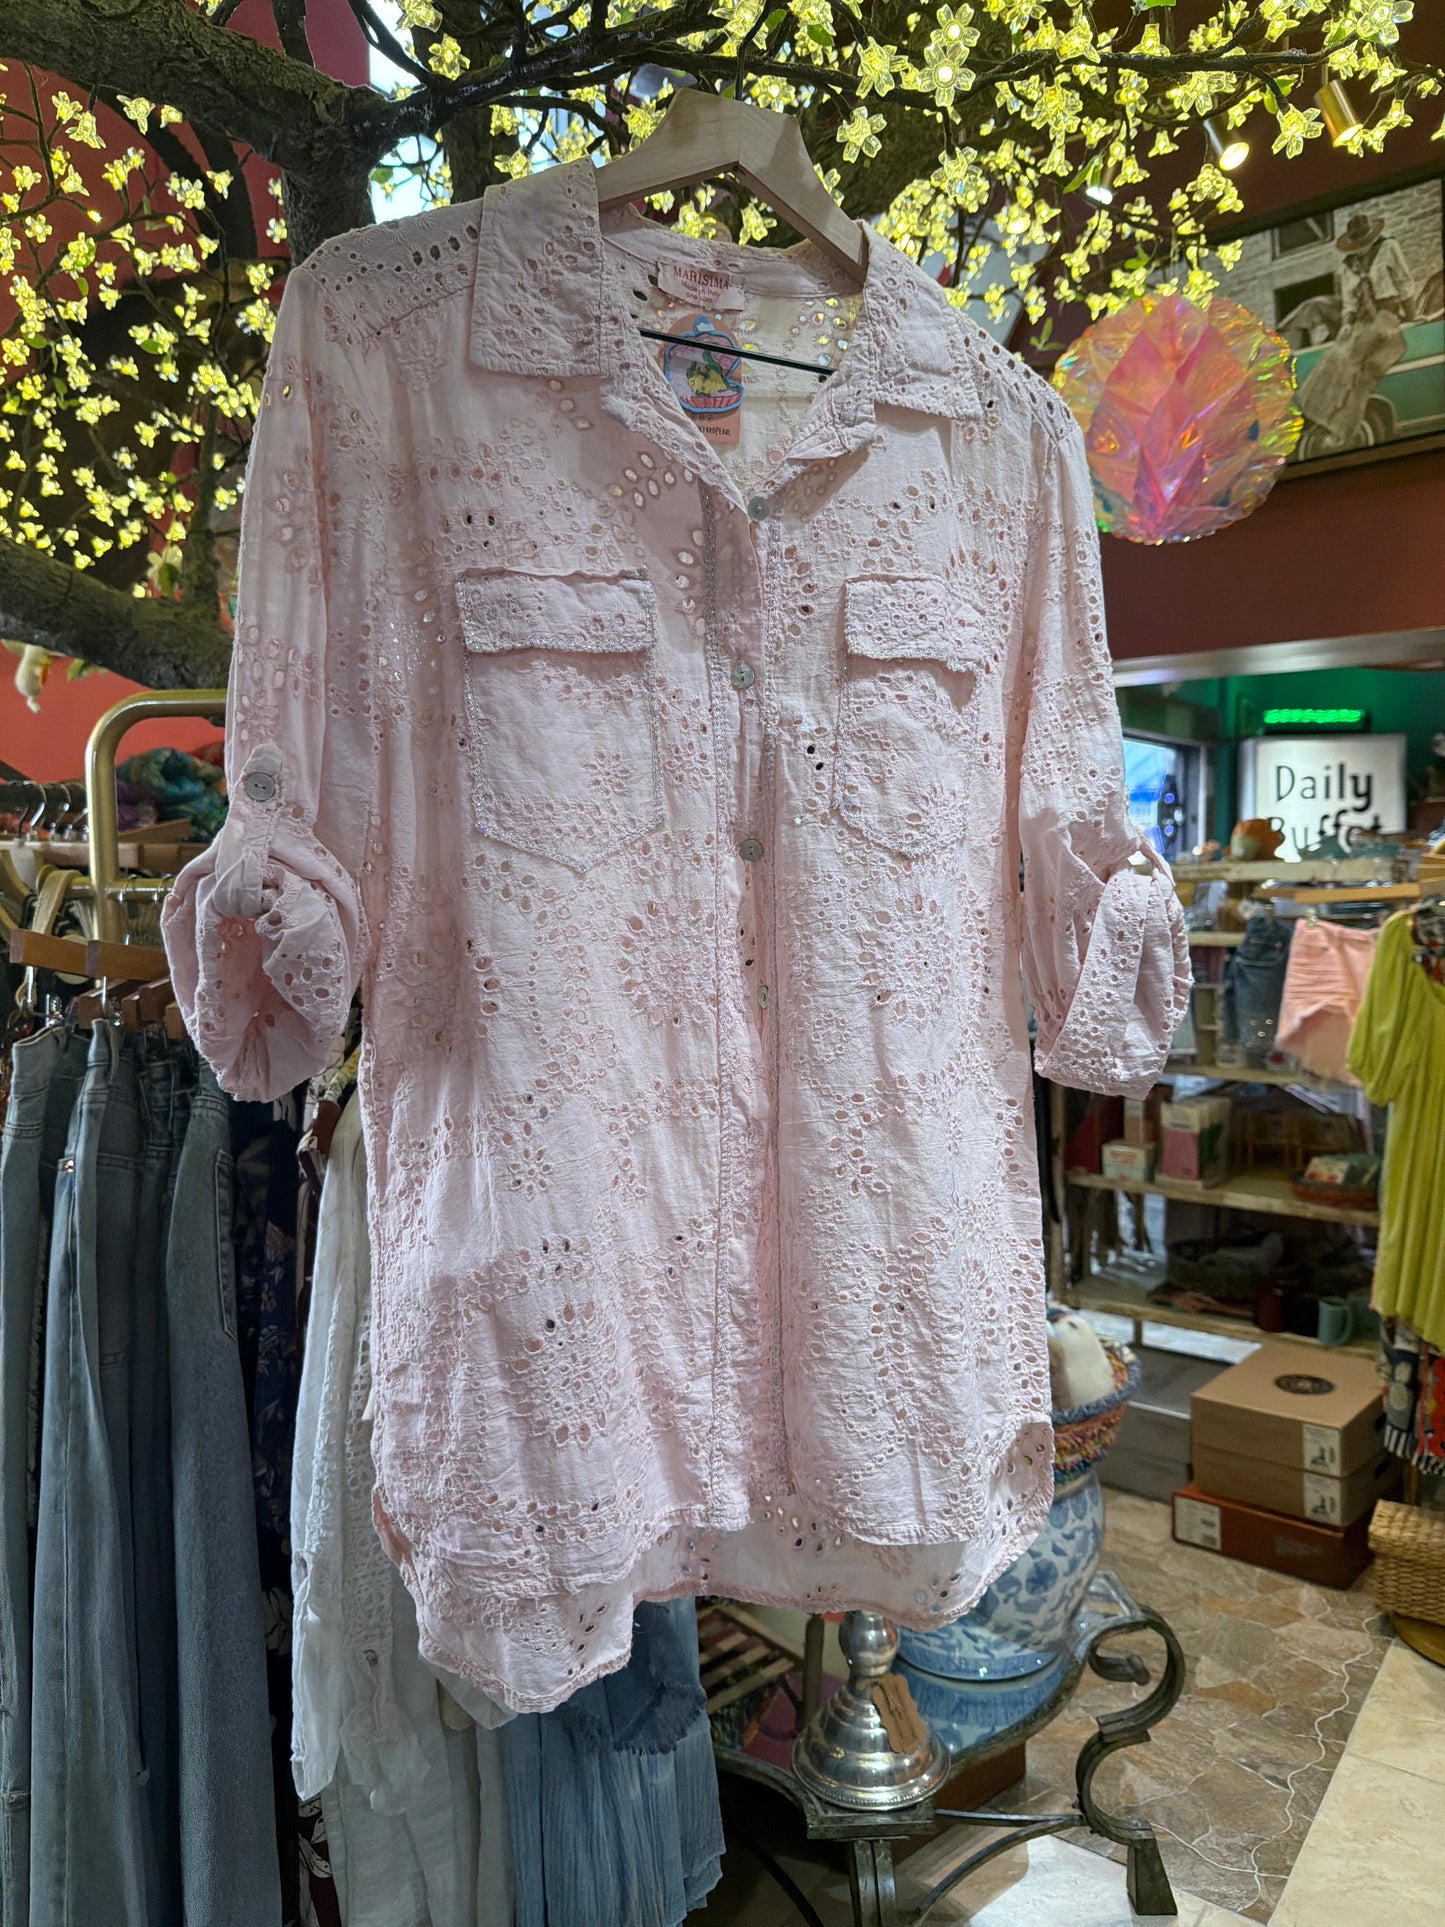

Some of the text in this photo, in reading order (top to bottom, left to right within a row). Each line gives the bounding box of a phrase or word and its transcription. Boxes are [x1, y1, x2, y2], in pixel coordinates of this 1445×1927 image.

[673, 264, 729, 290] MARISIMA
[681, 280, 698, 292] Made
[1275, 763, 1372, 813] Daily
